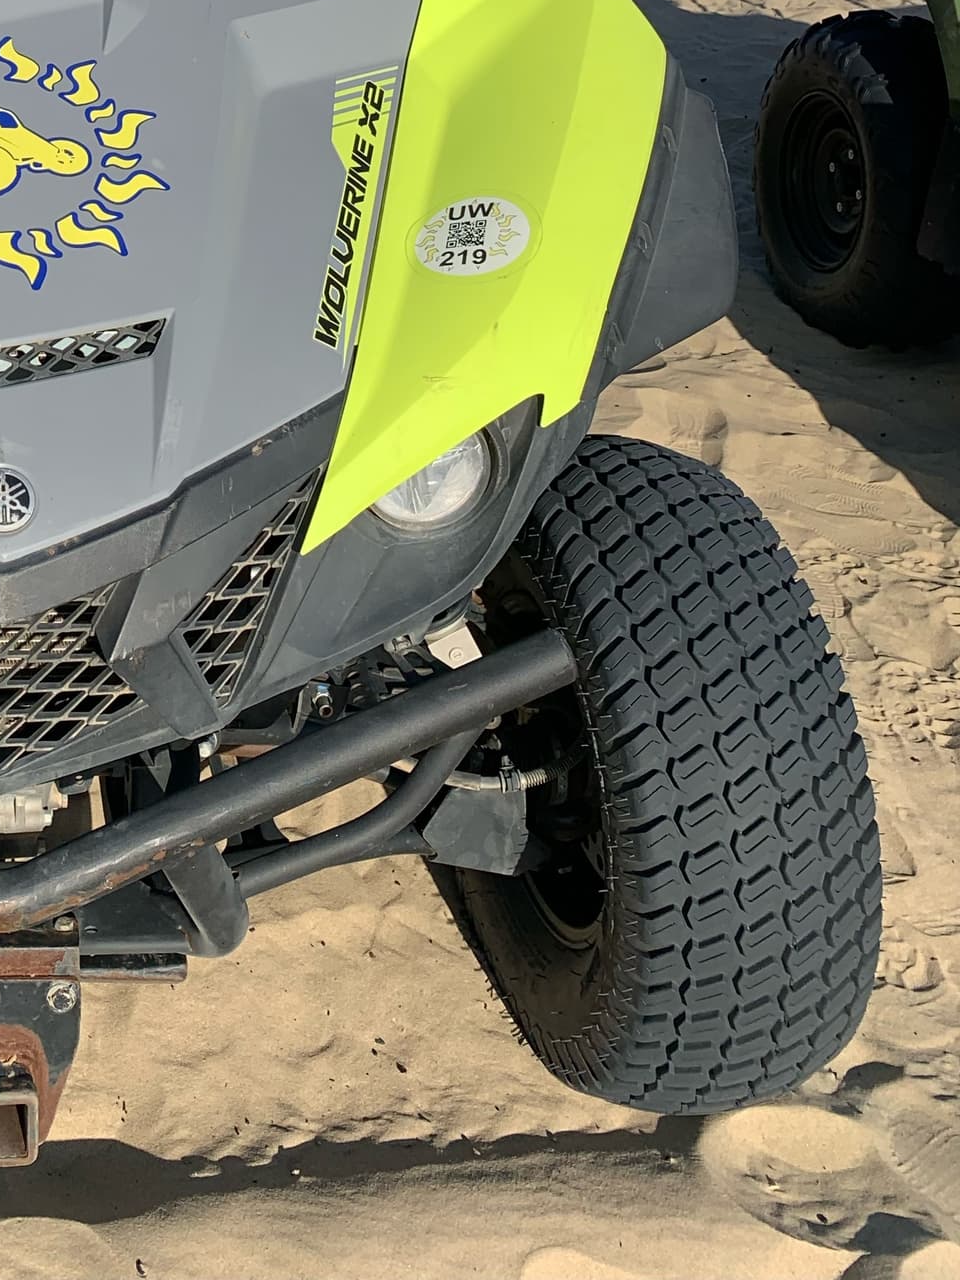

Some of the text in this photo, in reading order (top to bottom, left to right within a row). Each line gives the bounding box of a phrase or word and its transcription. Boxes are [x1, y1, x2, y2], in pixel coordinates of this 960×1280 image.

[313, 80, 385, 349] WOLVERINE X2
[448, 202, 495, 221] UW
[439, 249, 487, 267] 219
